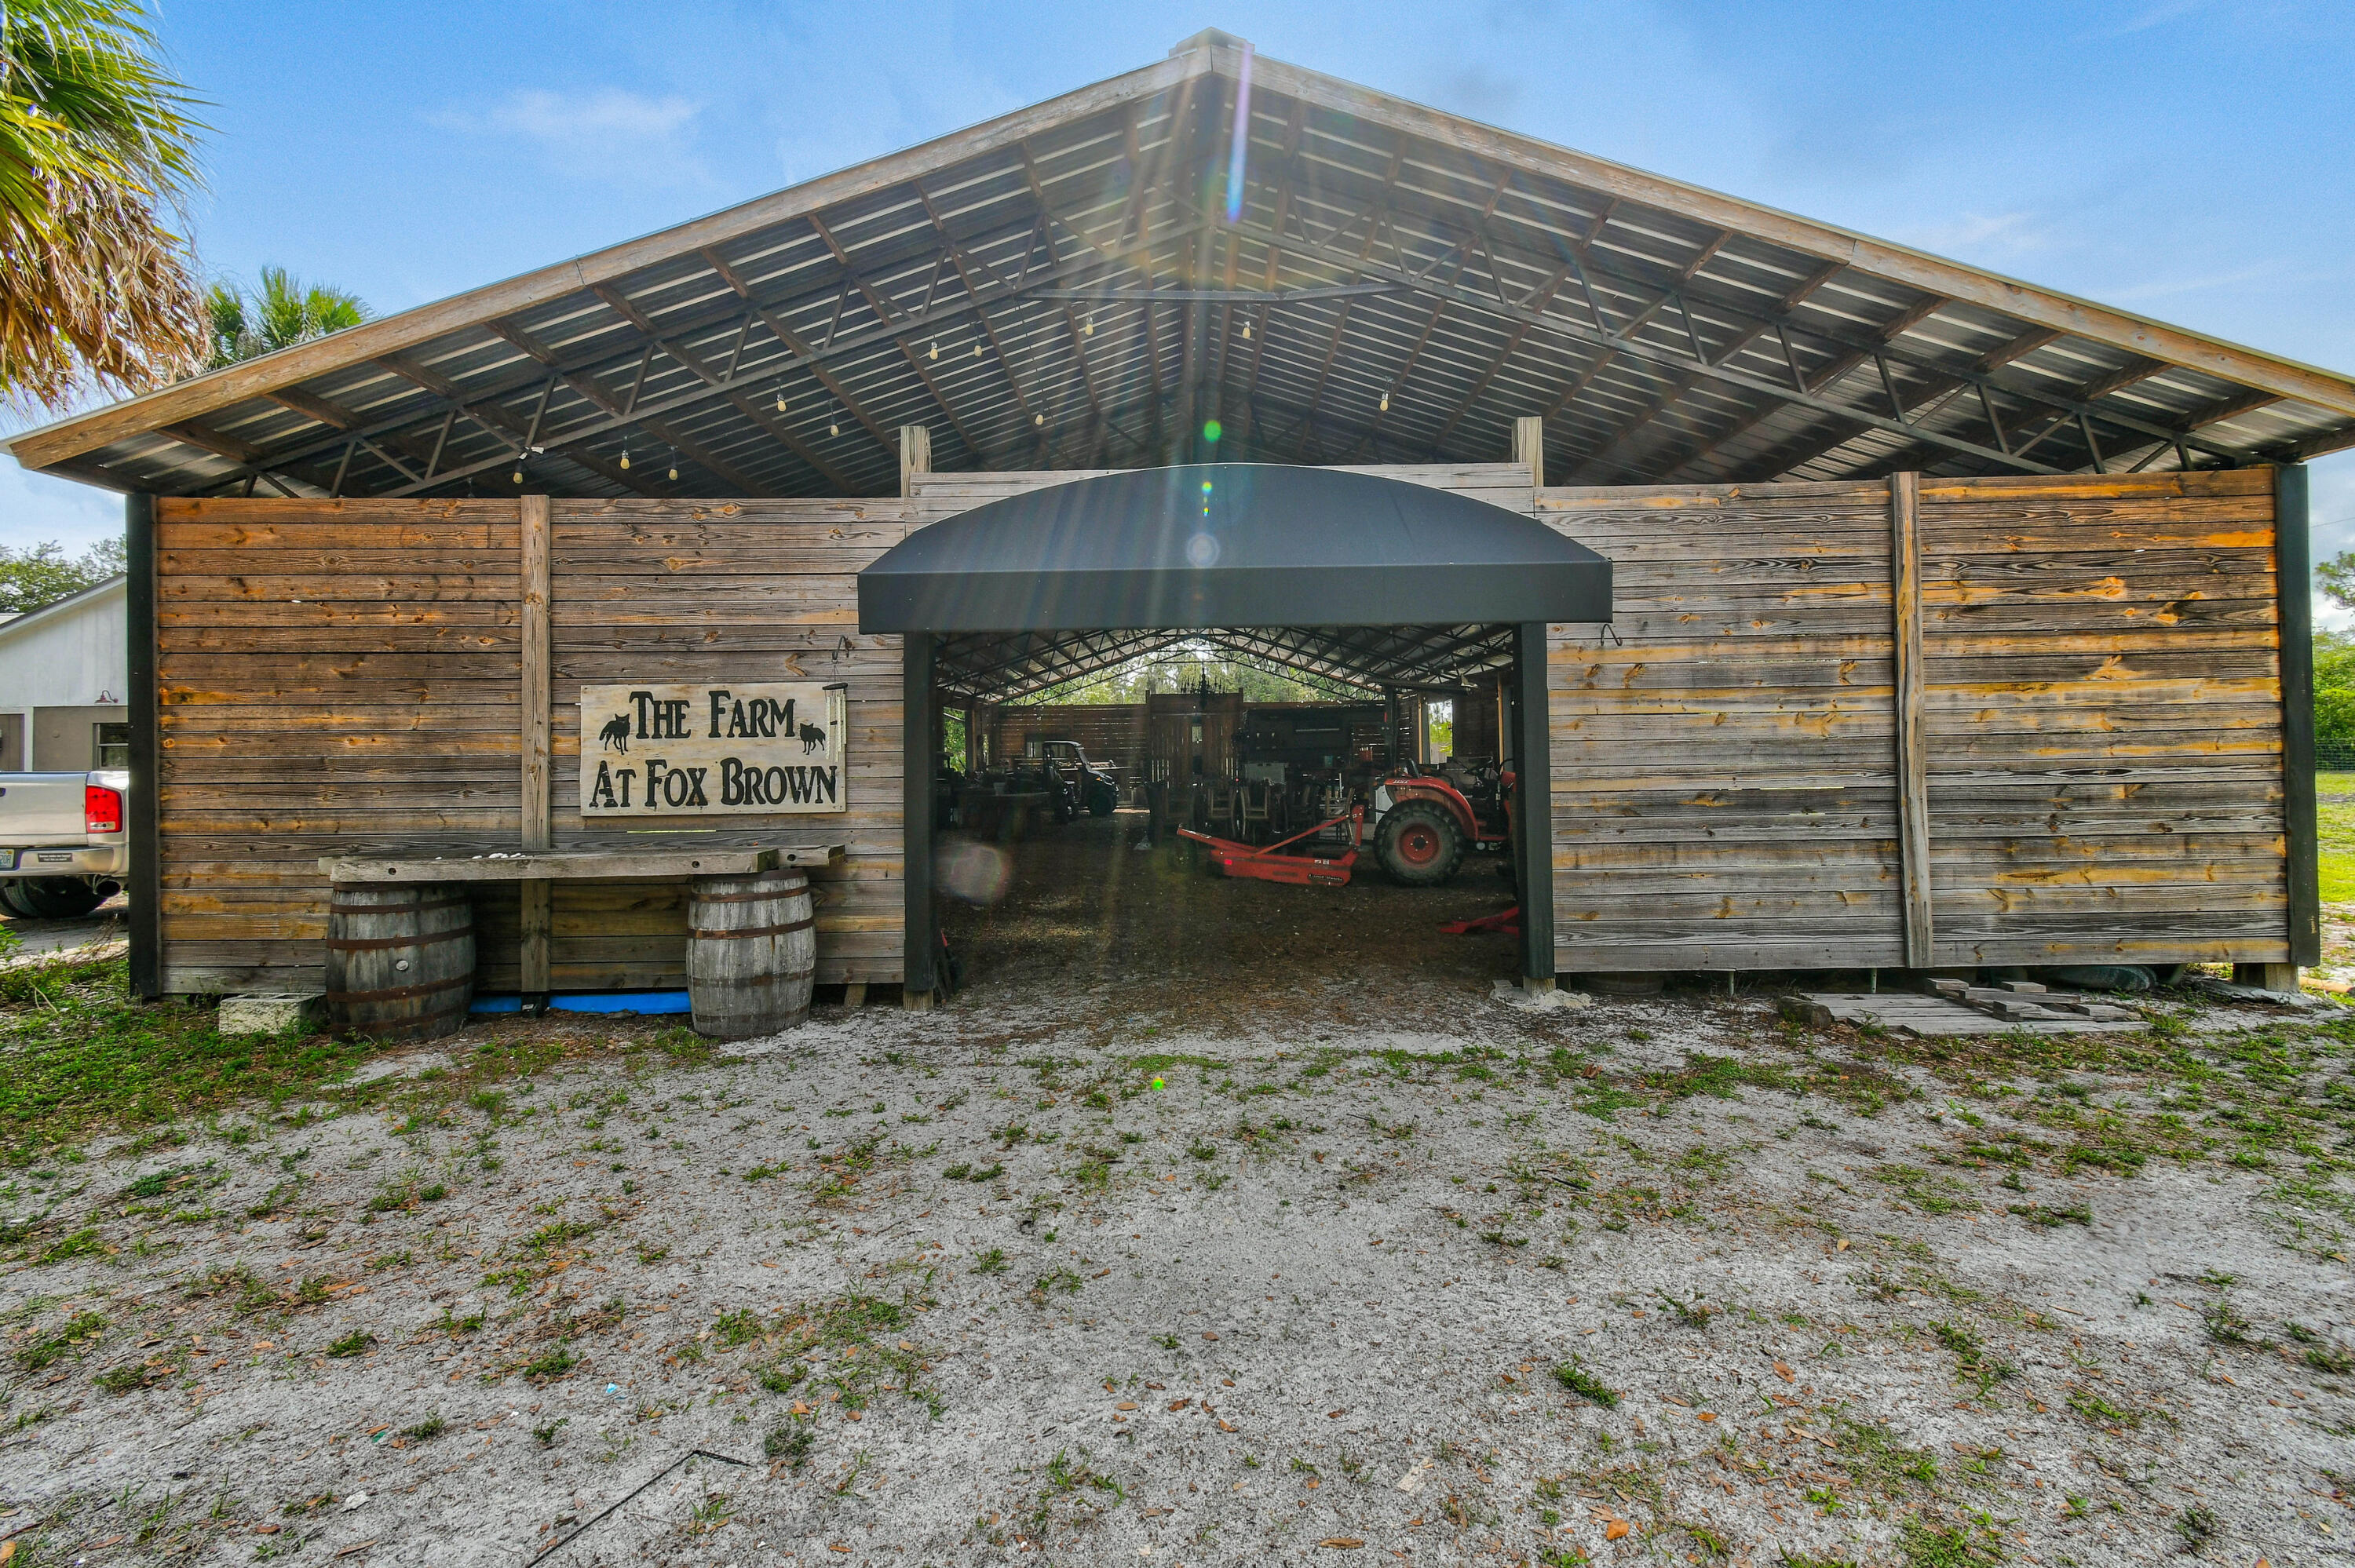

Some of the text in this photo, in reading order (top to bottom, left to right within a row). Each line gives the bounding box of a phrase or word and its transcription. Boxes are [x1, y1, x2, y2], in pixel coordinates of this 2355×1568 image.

[629, 690, 796, 739] THE FARM
[589, 757, 838, 808] AT FOX BROWN
